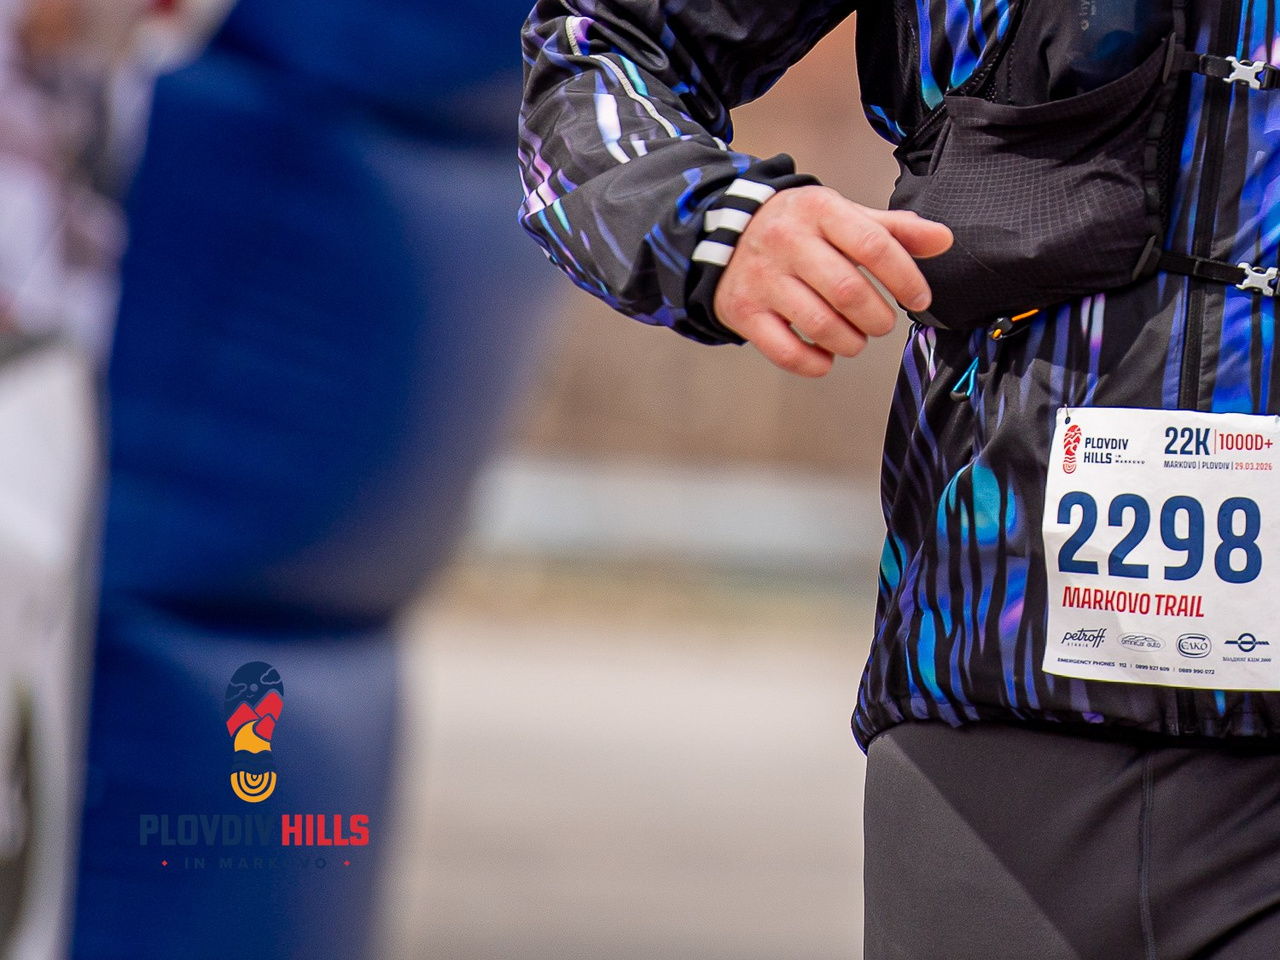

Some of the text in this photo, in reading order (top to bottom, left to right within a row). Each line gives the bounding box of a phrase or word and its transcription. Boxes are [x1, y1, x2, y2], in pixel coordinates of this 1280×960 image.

[1084, 437, 1129, 450] PLOVDIV
[1164, 426, 1273, 456] 22K 1000D+
[1083, 452, 1112, 464] HILLS
[1163, 460, 1273, 471] MARKOVO PLOVDIV 29.03.2026
[1056, 491, 1263, 584] 2298
[1062, 586, 1205, 618] MARKOVO TRAIL
[1057, 657, 1092, 665] EMERGENCY
